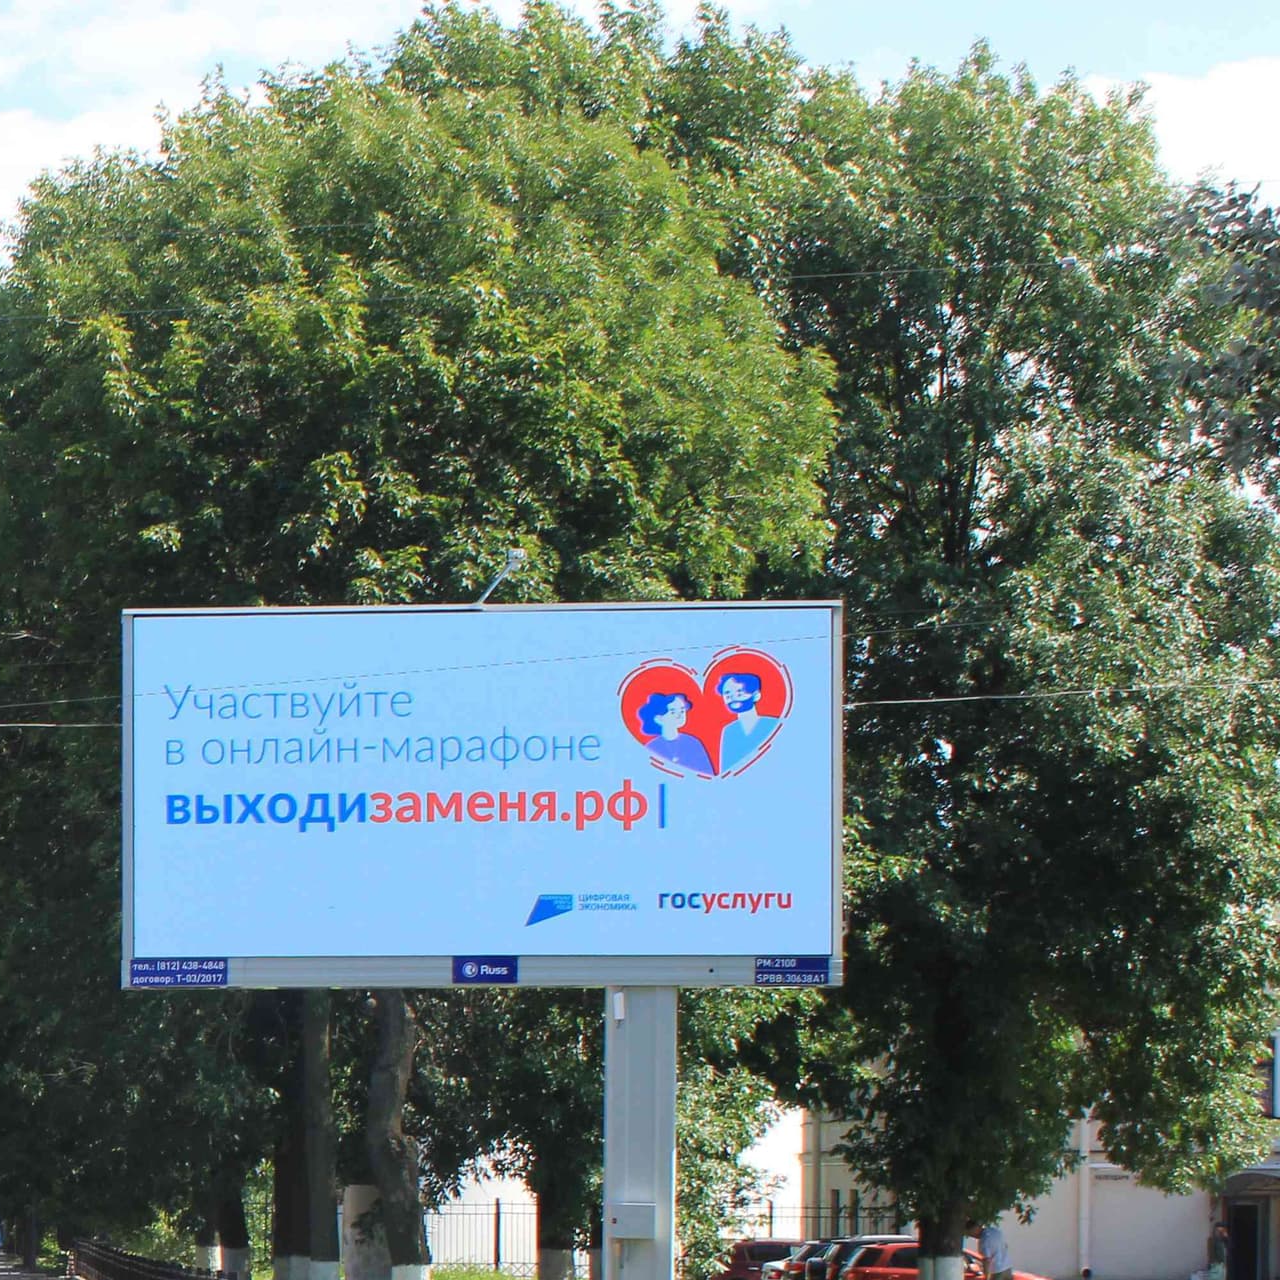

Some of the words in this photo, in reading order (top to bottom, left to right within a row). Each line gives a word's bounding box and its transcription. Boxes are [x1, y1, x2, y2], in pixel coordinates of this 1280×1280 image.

[163, 682, 414, 725] Участвуйте
[164, 739, 186, 765] в
[200, 726, 602, 770] онлайн-марафоне
[578, 894, 630, 903] ЦИФРОВАЯ
[578, 903, 638, 912] ЭКОНОМИКА
[132, 963, 155, 971] тел.:
[157, 961, 180, 972] (812)
[181, 961, 225, 970] 438-4848
[480, 964, 509, 975] Russ
[132, 976, 174, 985] договор:
